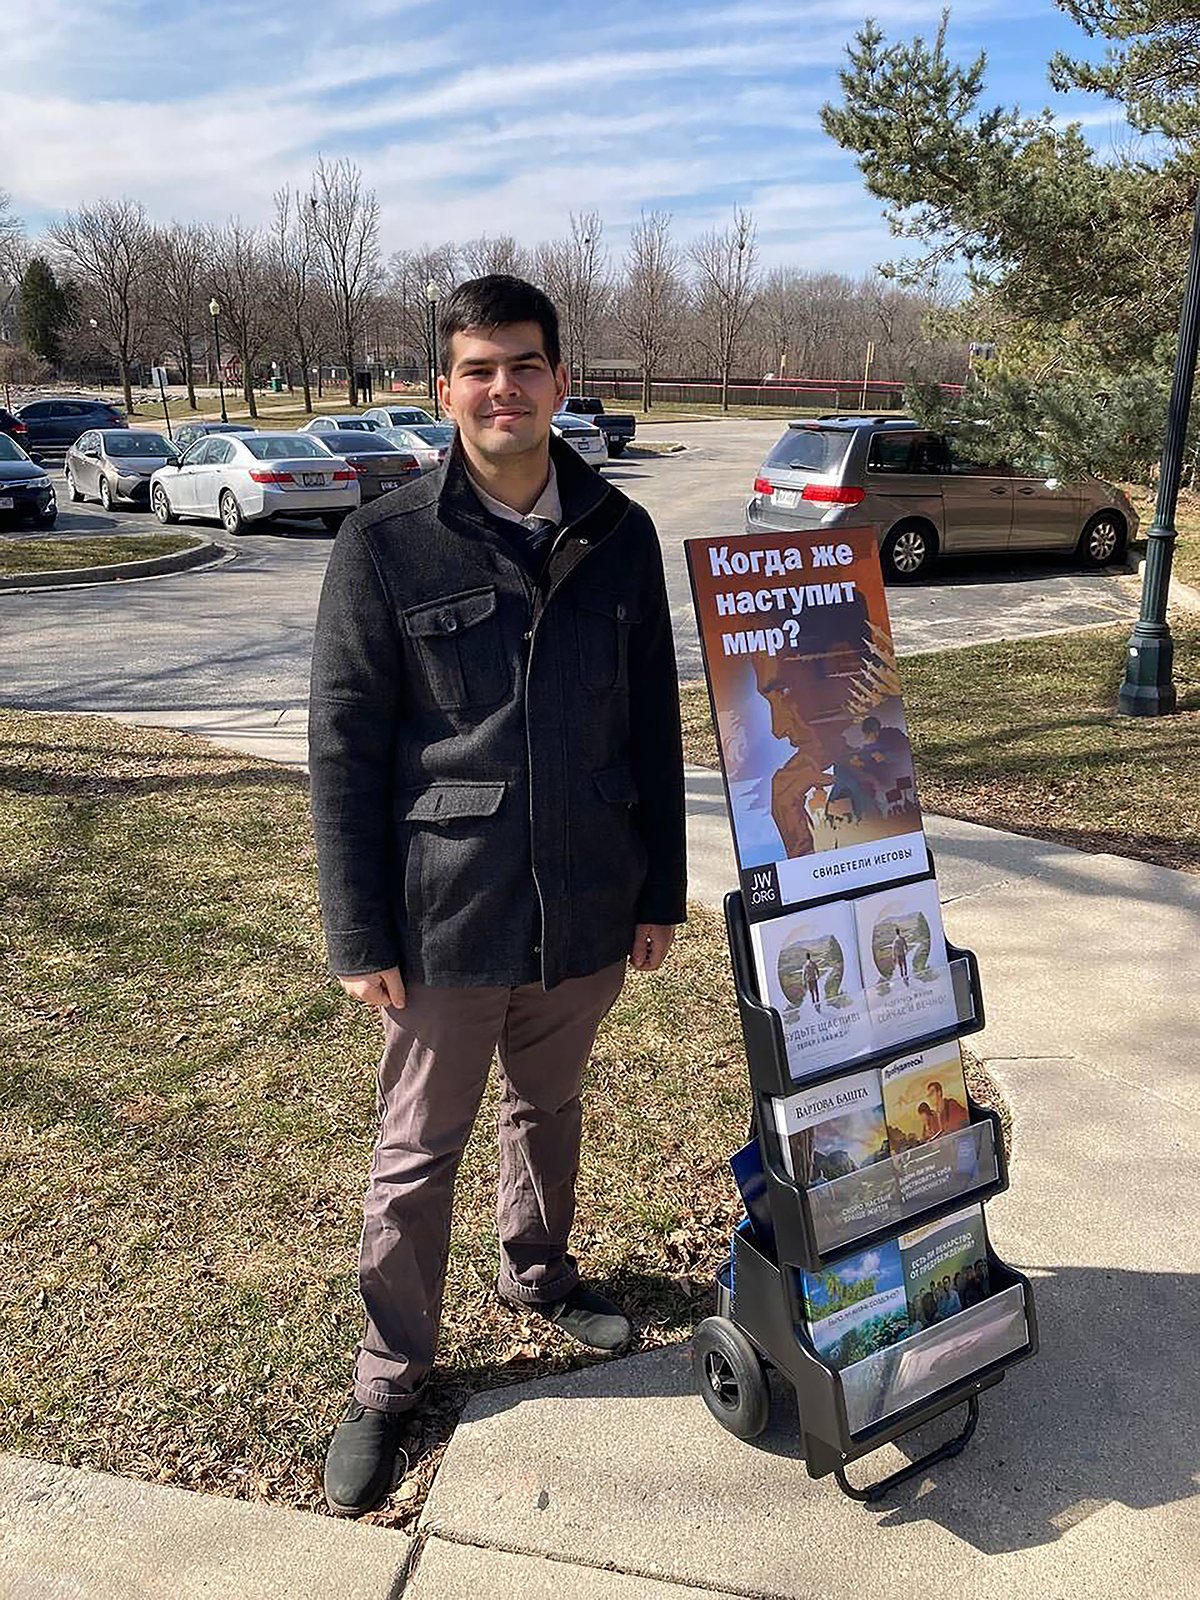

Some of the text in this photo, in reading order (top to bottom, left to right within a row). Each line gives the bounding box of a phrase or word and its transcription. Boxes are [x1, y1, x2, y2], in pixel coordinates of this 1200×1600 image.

[709, 543, 853, 577] Когда же
[716, 581, 855, 616] наступит
[722, 619, 800, 656] мир?
[813, 849, 912, 879] СВИДЕТЕЛИ ИЕГОВЫ
[751, 871, 772, 891] JW
[751, 888, 775, 905] .ORG
[795, 1098, 834, 1119] ВАРТОВА
[836, 1088, 869, 1105] БАШТА
